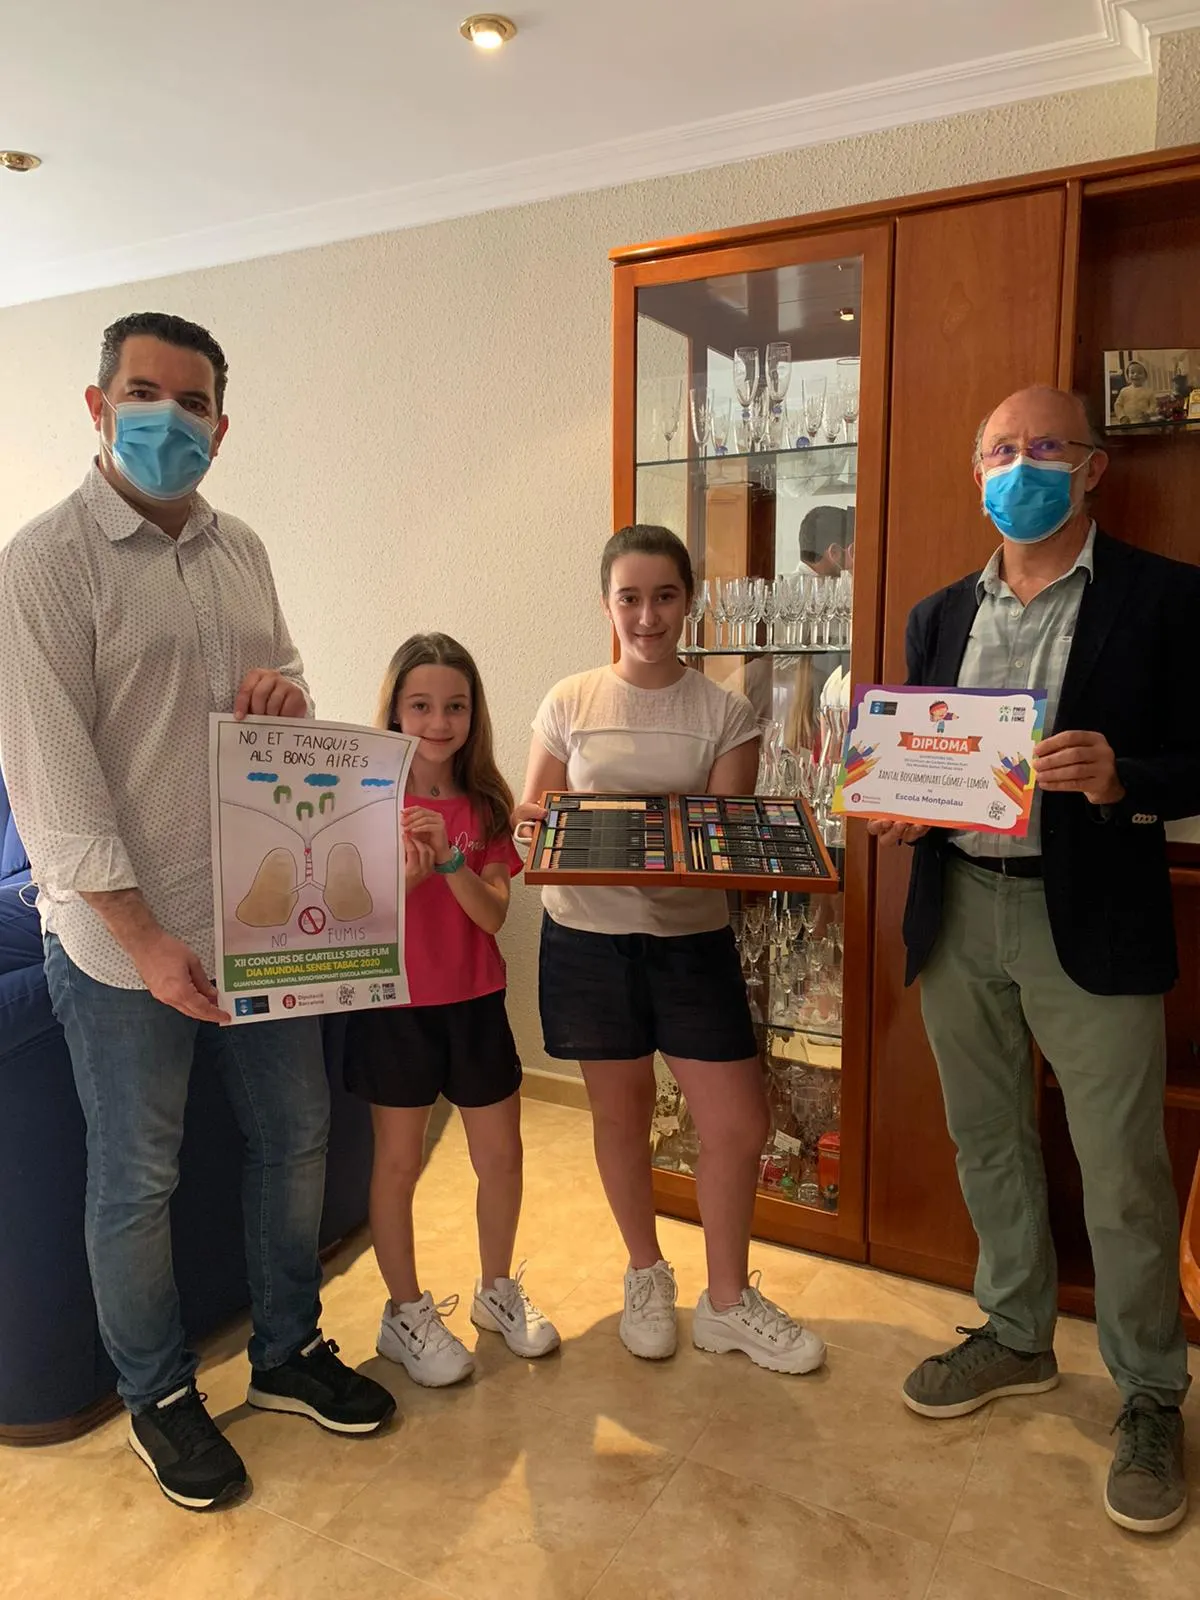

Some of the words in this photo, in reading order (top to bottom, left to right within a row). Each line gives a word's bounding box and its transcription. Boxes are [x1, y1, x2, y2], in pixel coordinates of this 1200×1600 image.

[239, 731, 258, 745] NO
[267, 732, 284, 745] ET
[911, 737, 969, 752] DIPLOMA
[250, 750, 273, 763] ALS
[283, 750, 316, 766] BONS
[325, 753, 369, 768] AIRES
[895, 793, 920, 802] Escola
[921, 795, 964, 807] Montpalau
[271, 933, 288, 948] NO
[328, 927, 366, 944] FUMIS
[234, 958, 246, 968] XII
[247, 955, 291, 967] CONCURS
[292, 953, 304, 963] DE
[305, 950, 345, 962] CARTELLS
[345, 949, 370, 959] SENSE
[371, 947, 390, 957] FUM
[246, 968, 262, 978] DIA
[263, 965, 304, 976] MUNDIAL
[306, 963, 332, 973] SENSE
[333, 960, 359, 970] TABAC
[360, 958, 381, 968] 2020
